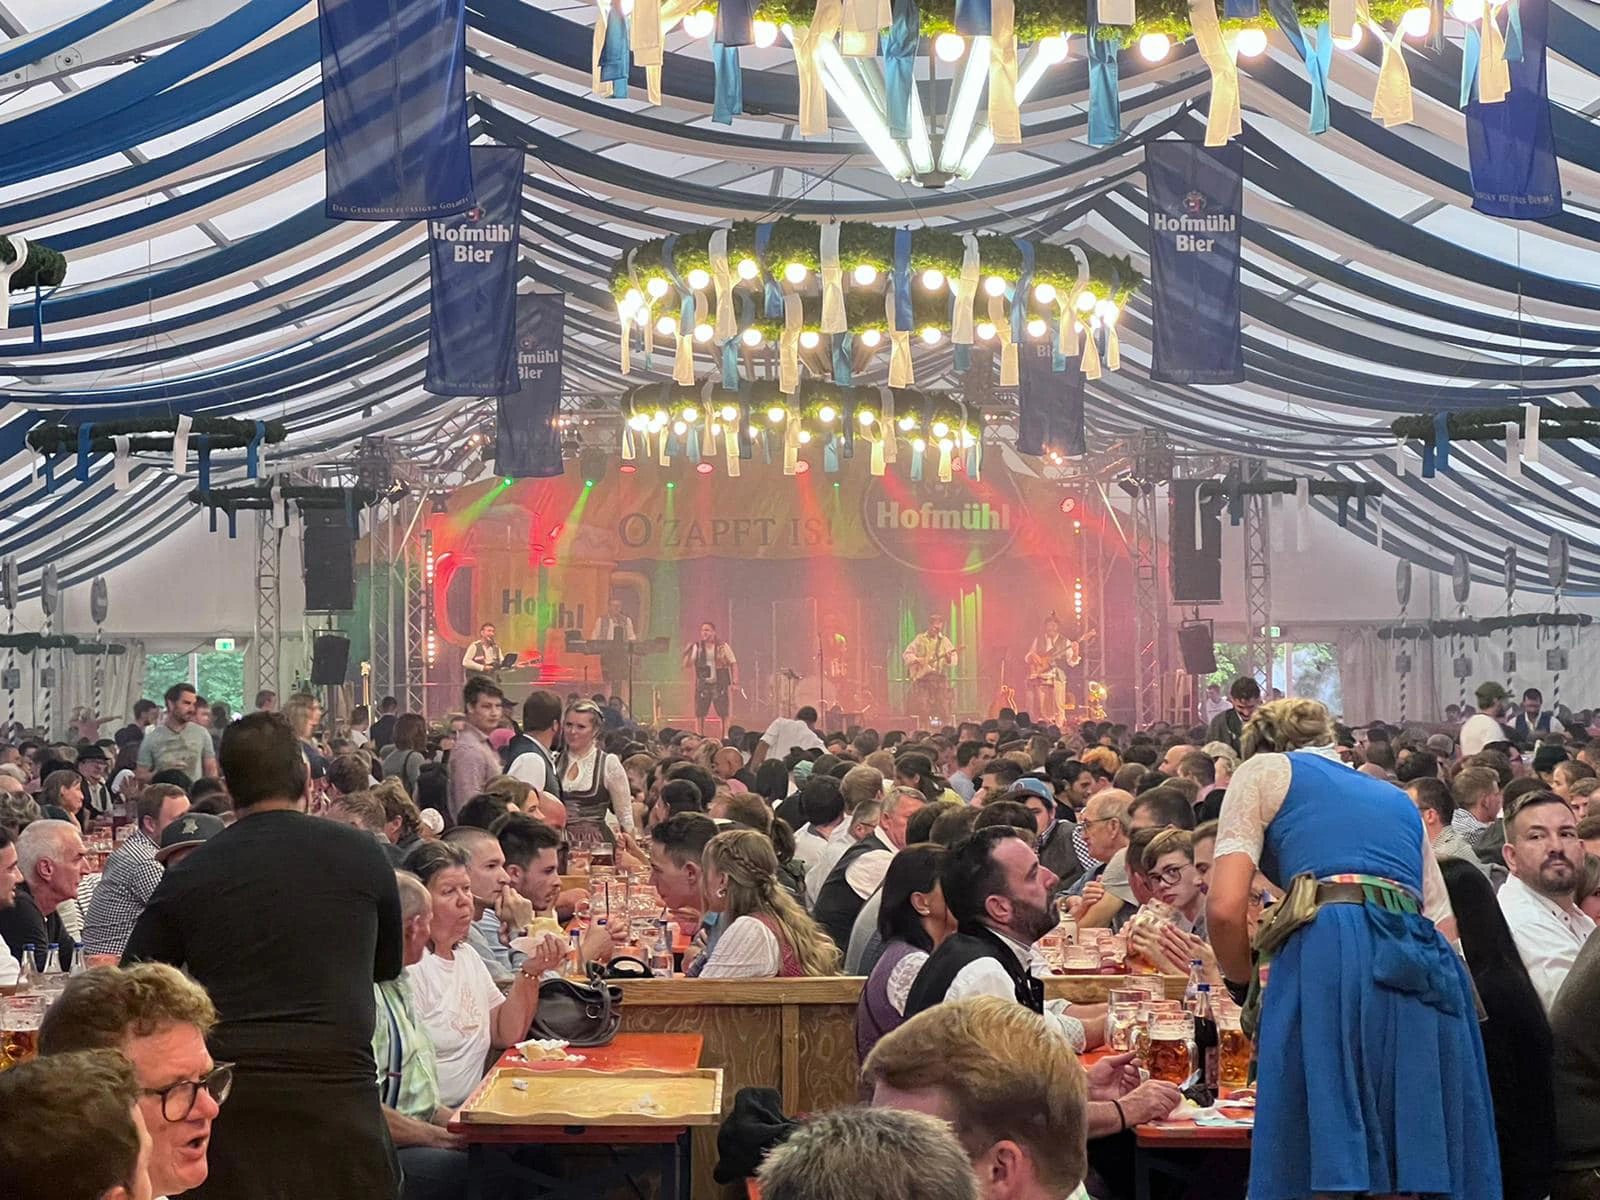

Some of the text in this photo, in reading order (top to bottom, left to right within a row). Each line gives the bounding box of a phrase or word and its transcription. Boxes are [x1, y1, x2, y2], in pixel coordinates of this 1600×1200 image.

[432, 221, 514, 242] Hofmühl
[1153, 213, 1236, 232] Hofmühl
[1175, 234, 1215, 253] Bier
[454, 244, 494, 263] Bier
[518, 350, 559, 365] fmühl
[876, 500, 1011, 530] Hofmühl
[618, 511, 833, 548] O'ZAPFT IS!
